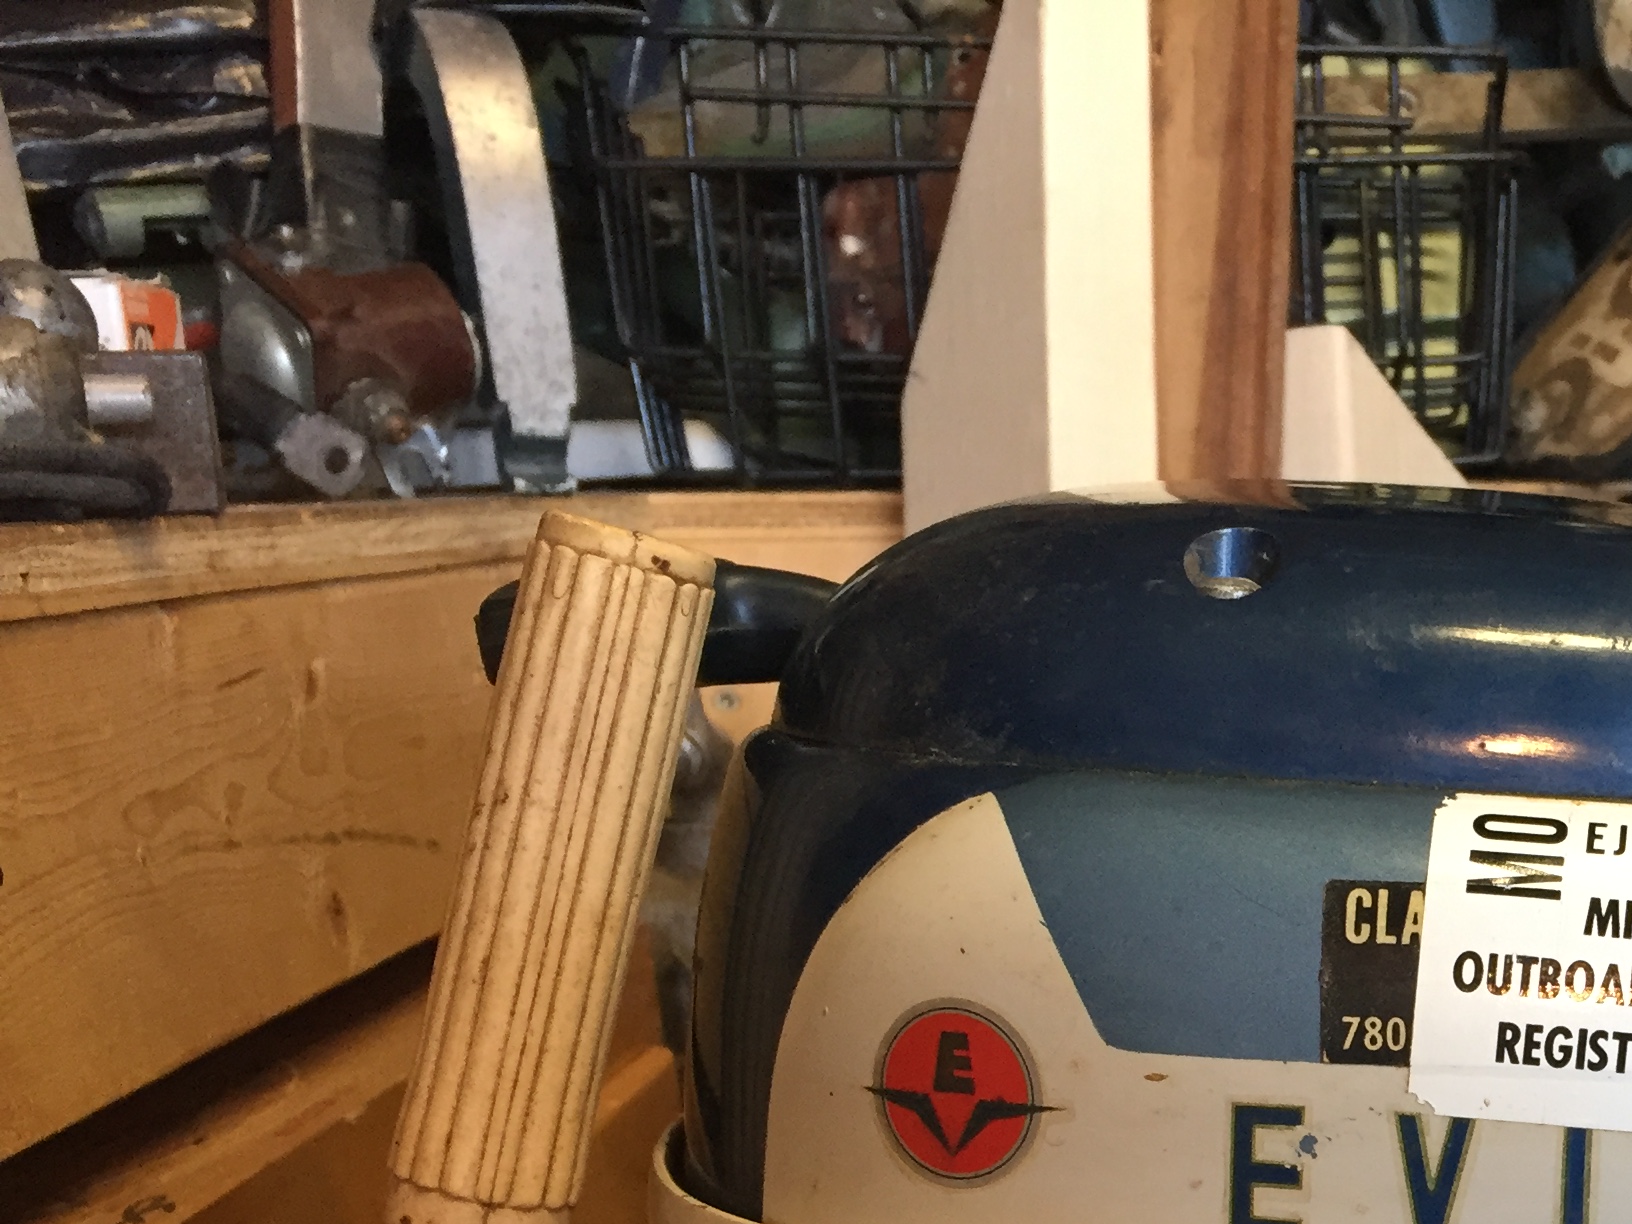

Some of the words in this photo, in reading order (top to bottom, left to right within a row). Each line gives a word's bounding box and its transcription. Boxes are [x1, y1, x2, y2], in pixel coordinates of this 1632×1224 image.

[1466, 813, 1568, 900] MO
[1585, 821, 1628, 855] EJ
[933, 1031, 976, 1095] E
